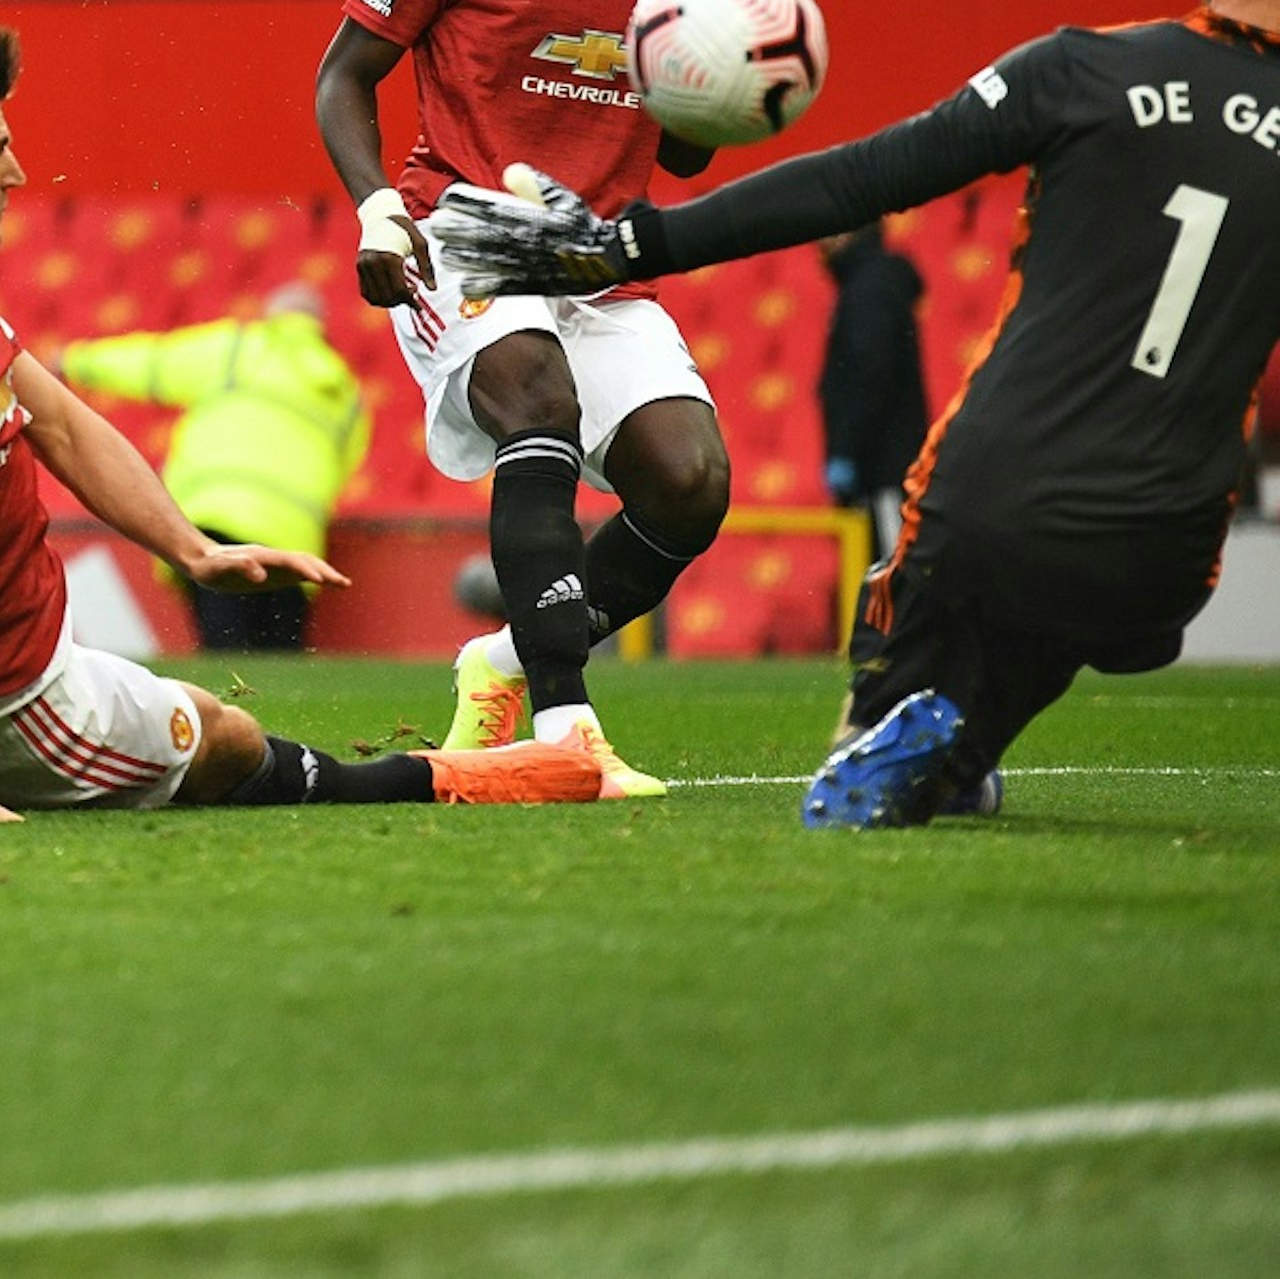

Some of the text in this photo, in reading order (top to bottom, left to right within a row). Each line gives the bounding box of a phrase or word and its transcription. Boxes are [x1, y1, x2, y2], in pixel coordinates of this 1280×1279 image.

[521, 75, 641, 109] CHEVROLE
[1126, 82, 1280, 157] DE GE
[1131, 183, 1229, 378] 1
